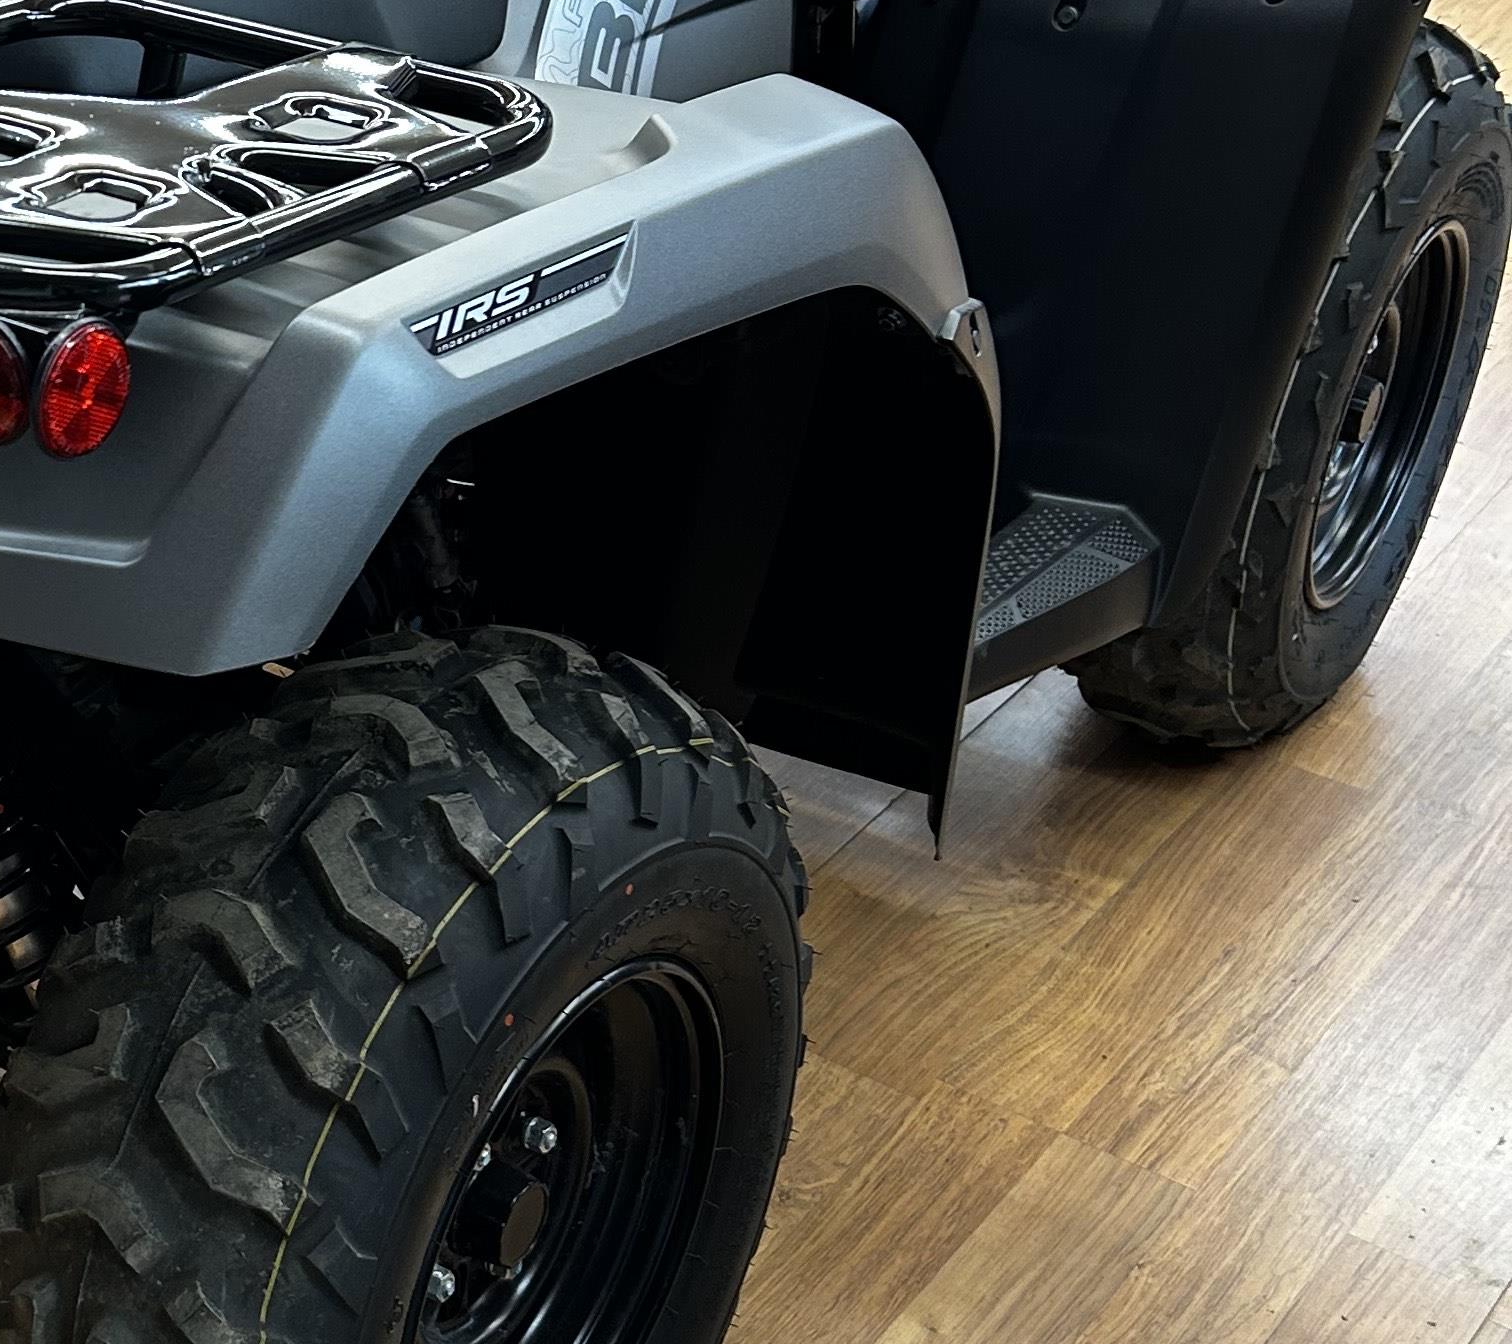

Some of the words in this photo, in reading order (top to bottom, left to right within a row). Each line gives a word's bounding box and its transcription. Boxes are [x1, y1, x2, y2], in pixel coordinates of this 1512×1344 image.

[435, 273, 535, 341] IRS
[437, 314, 513, 353] INDEPENDENT
[544, 272, 607, 306] SUSPENSION
